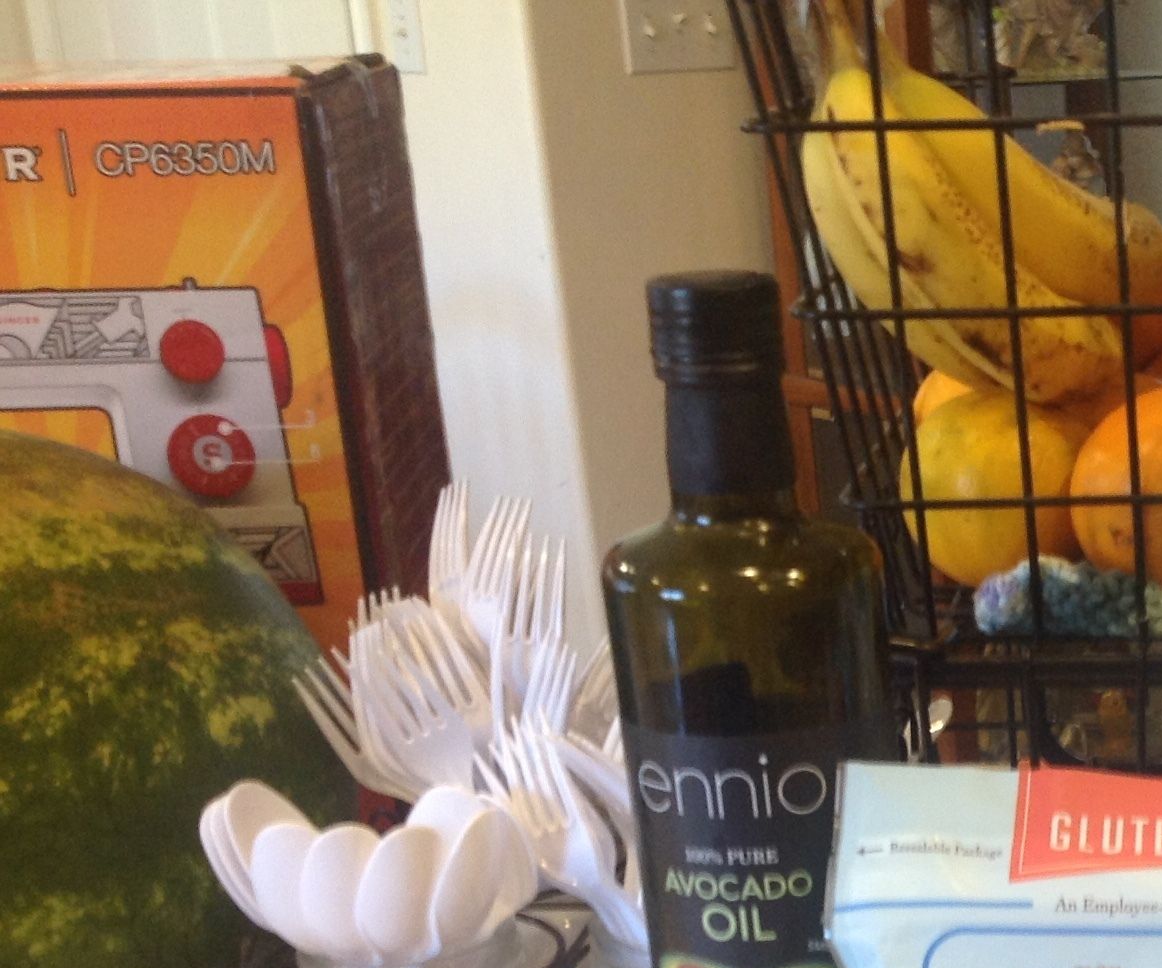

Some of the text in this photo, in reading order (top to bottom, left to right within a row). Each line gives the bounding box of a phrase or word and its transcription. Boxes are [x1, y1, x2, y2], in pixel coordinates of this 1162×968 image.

[95, 141, 276, 176] CP6350M
[638, 753, 827, 820] ennio
[727, 847, 779, 866] PURE
[665, 867, 813, 902] AVOCADO
[702, 902, 777, 942] OIL
[1055, 898, 1077, 914] An
